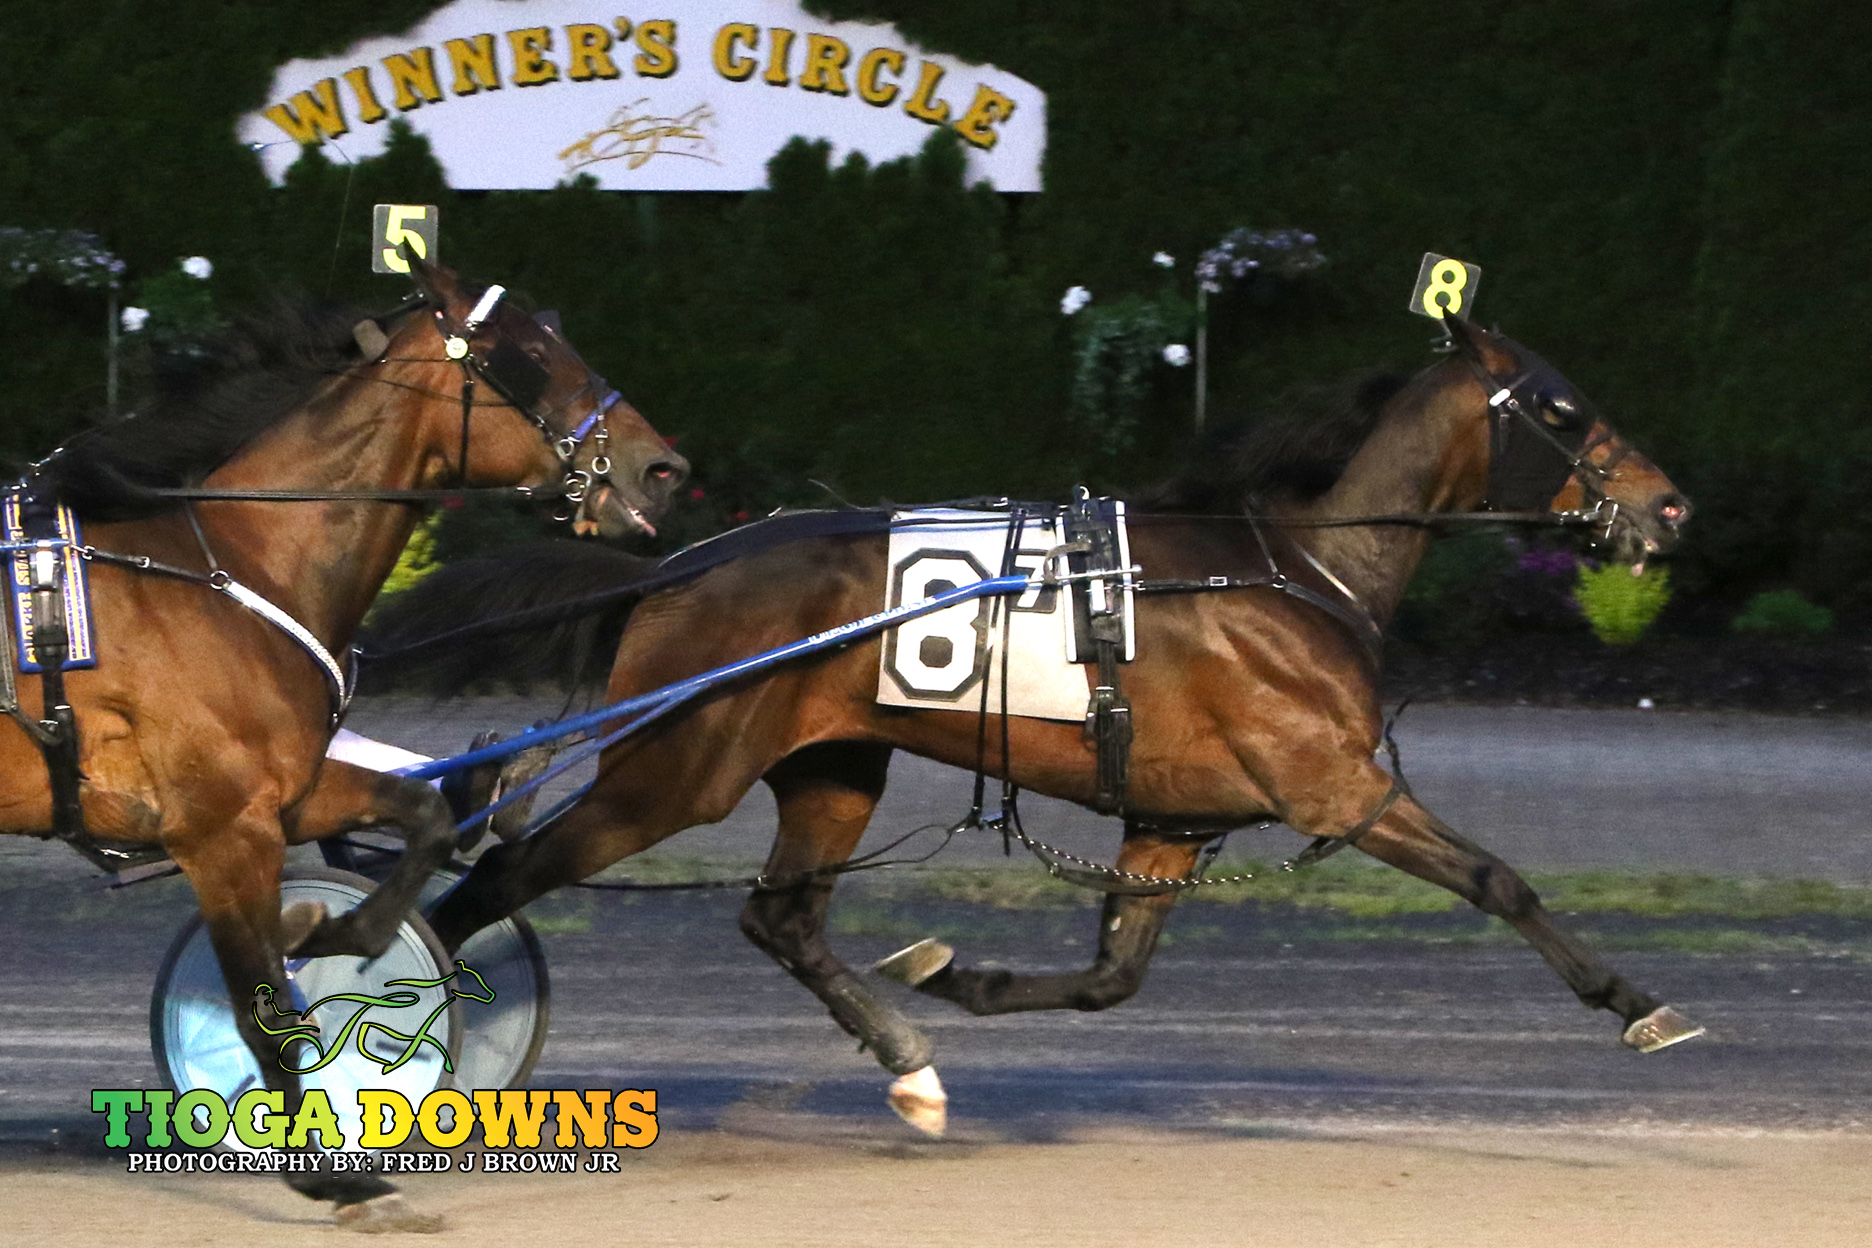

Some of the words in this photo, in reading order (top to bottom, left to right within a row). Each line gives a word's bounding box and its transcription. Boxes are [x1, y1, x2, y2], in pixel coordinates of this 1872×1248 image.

[265, 16, 678, 147] WINNER'S
[711, 21, 1017, 149] CIRCLE
[383, 205, 427, 273] 5
[1423, 258, 1468, 320] 8
[1014, 554, 1053, 608] 7
[885, 548, 993, 702] 8
